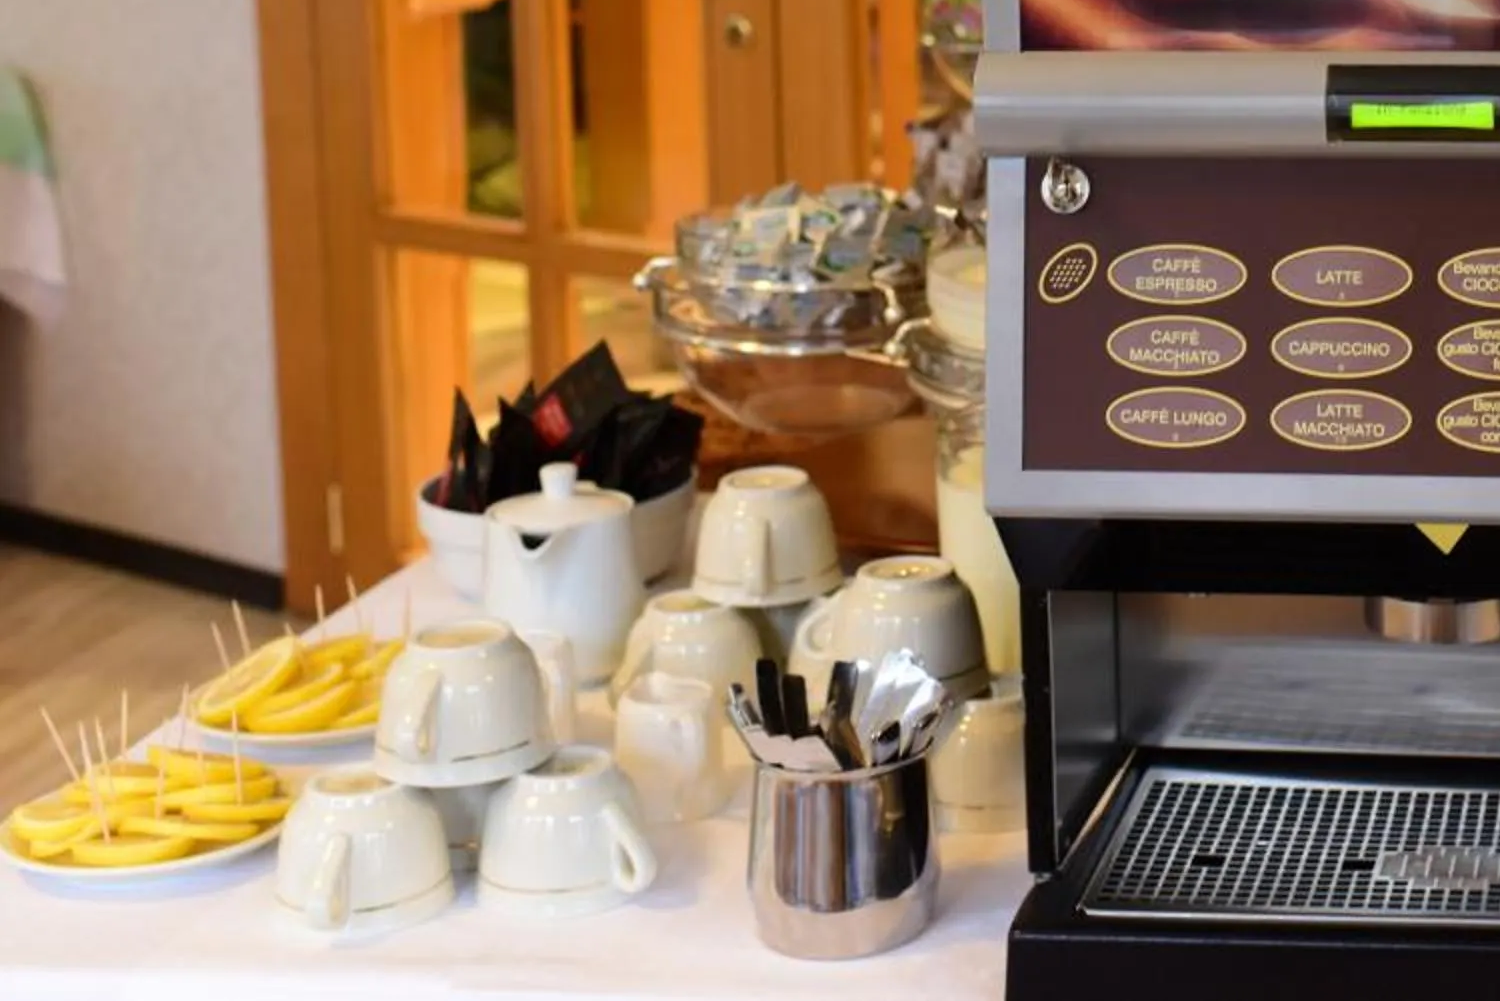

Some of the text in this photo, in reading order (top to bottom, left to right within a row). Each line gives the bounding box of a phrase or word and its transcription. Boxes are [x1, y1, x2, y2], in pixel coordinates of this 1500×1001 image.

[1135, 276, 1217, 293] ESPRESSO
[1315, 270, 1363, 285] LATTE
[1129, 347, 1221, 365] MACCHIATO
[1288, 341, 1391, 357] CAPPUCCINO
[1172, 410, 1228, 427] LUNGO
[1316, 401, 1364, 419] LATTE
[1293, 421, 1385, 438] MACCHIATO
